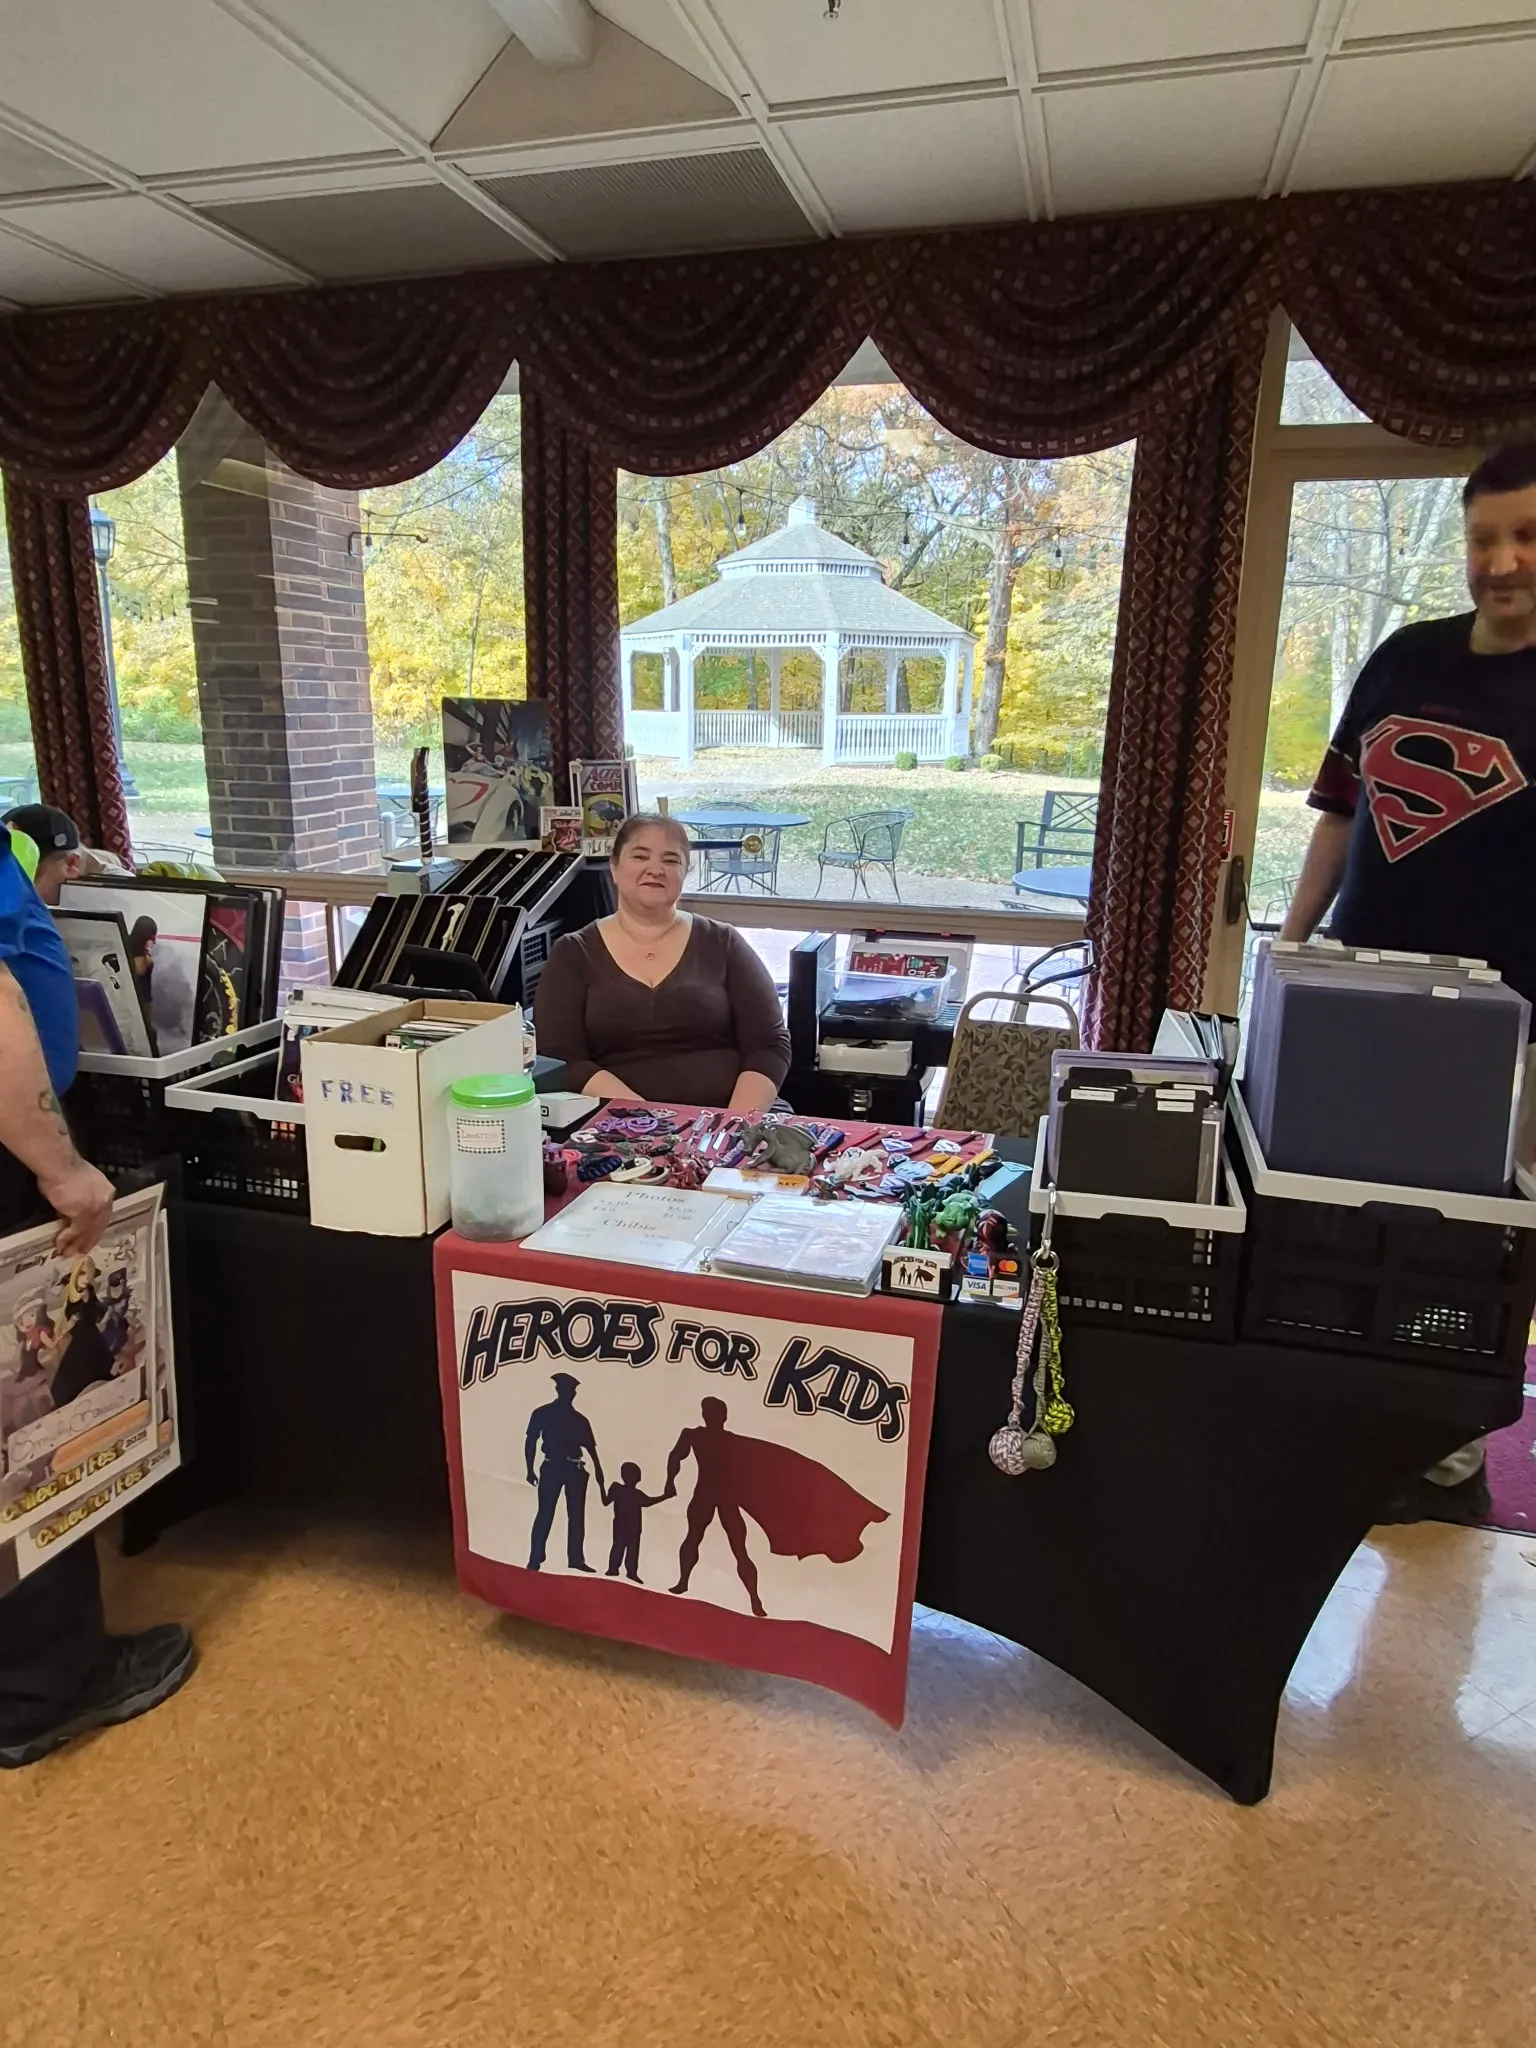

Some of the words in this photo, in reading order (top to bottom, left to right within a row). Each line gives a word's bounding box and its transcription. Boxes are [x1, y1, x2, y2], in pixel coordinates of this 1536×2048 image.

[320, 1079, 395, 1107] FREE
[626, 1191, 685, 1203] Photos
[967, 1280, 987, 1290] VISA
[461, 1297, 665, 1390] HEROES
[666, 1320, 760, 1380] FOR
[764, 1335, 909, 1442] KIDS
